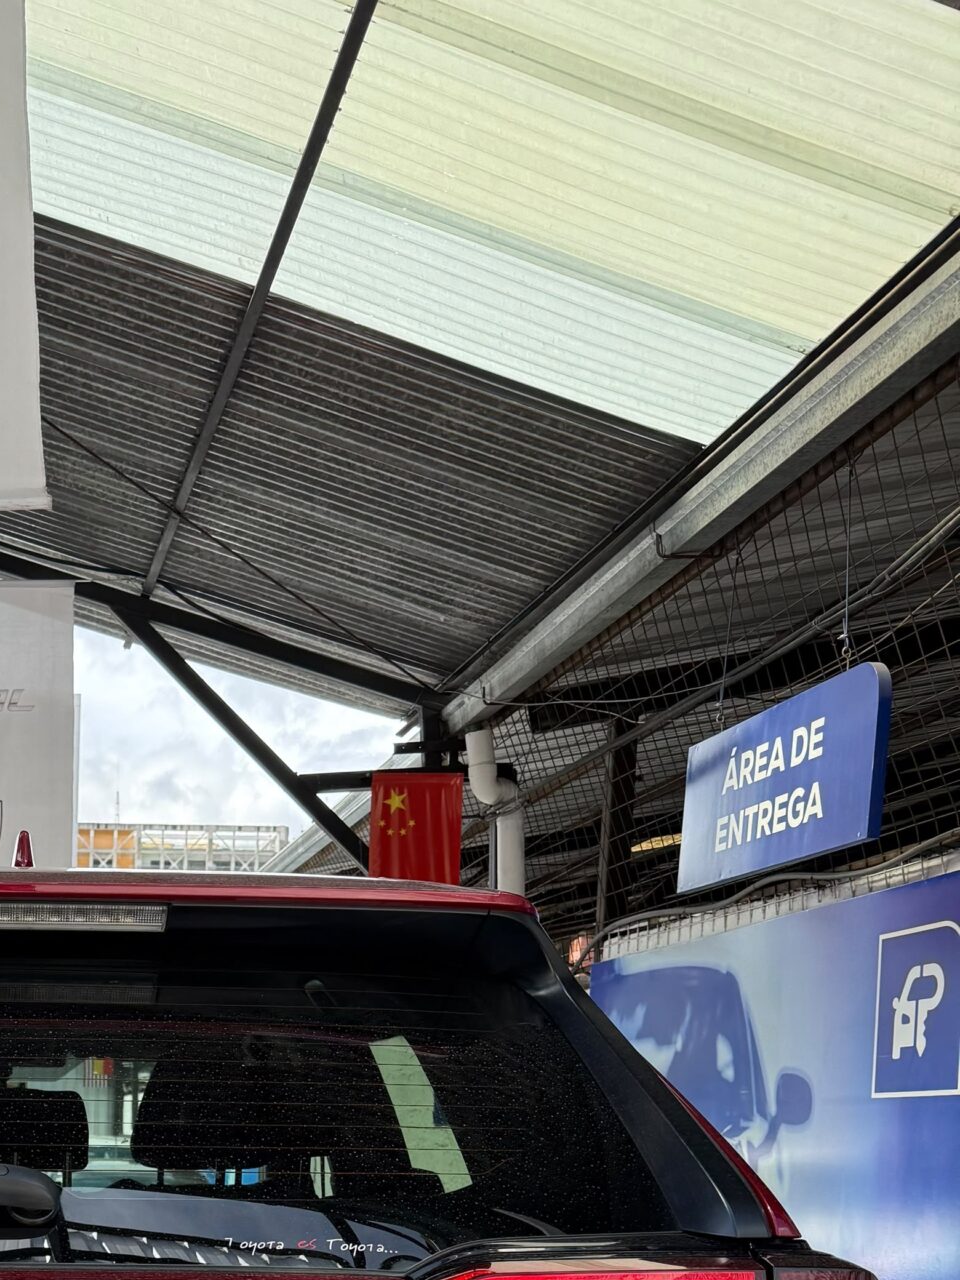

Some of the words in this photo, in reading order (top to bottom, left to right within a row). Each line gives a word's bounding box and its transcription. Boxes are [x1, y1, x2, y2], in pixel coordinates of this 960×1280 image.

[721, 736, 786, 796] ÁREA
[790, 716, 826, 768] DE
[714, 781, 824, 853] ENTREGA
